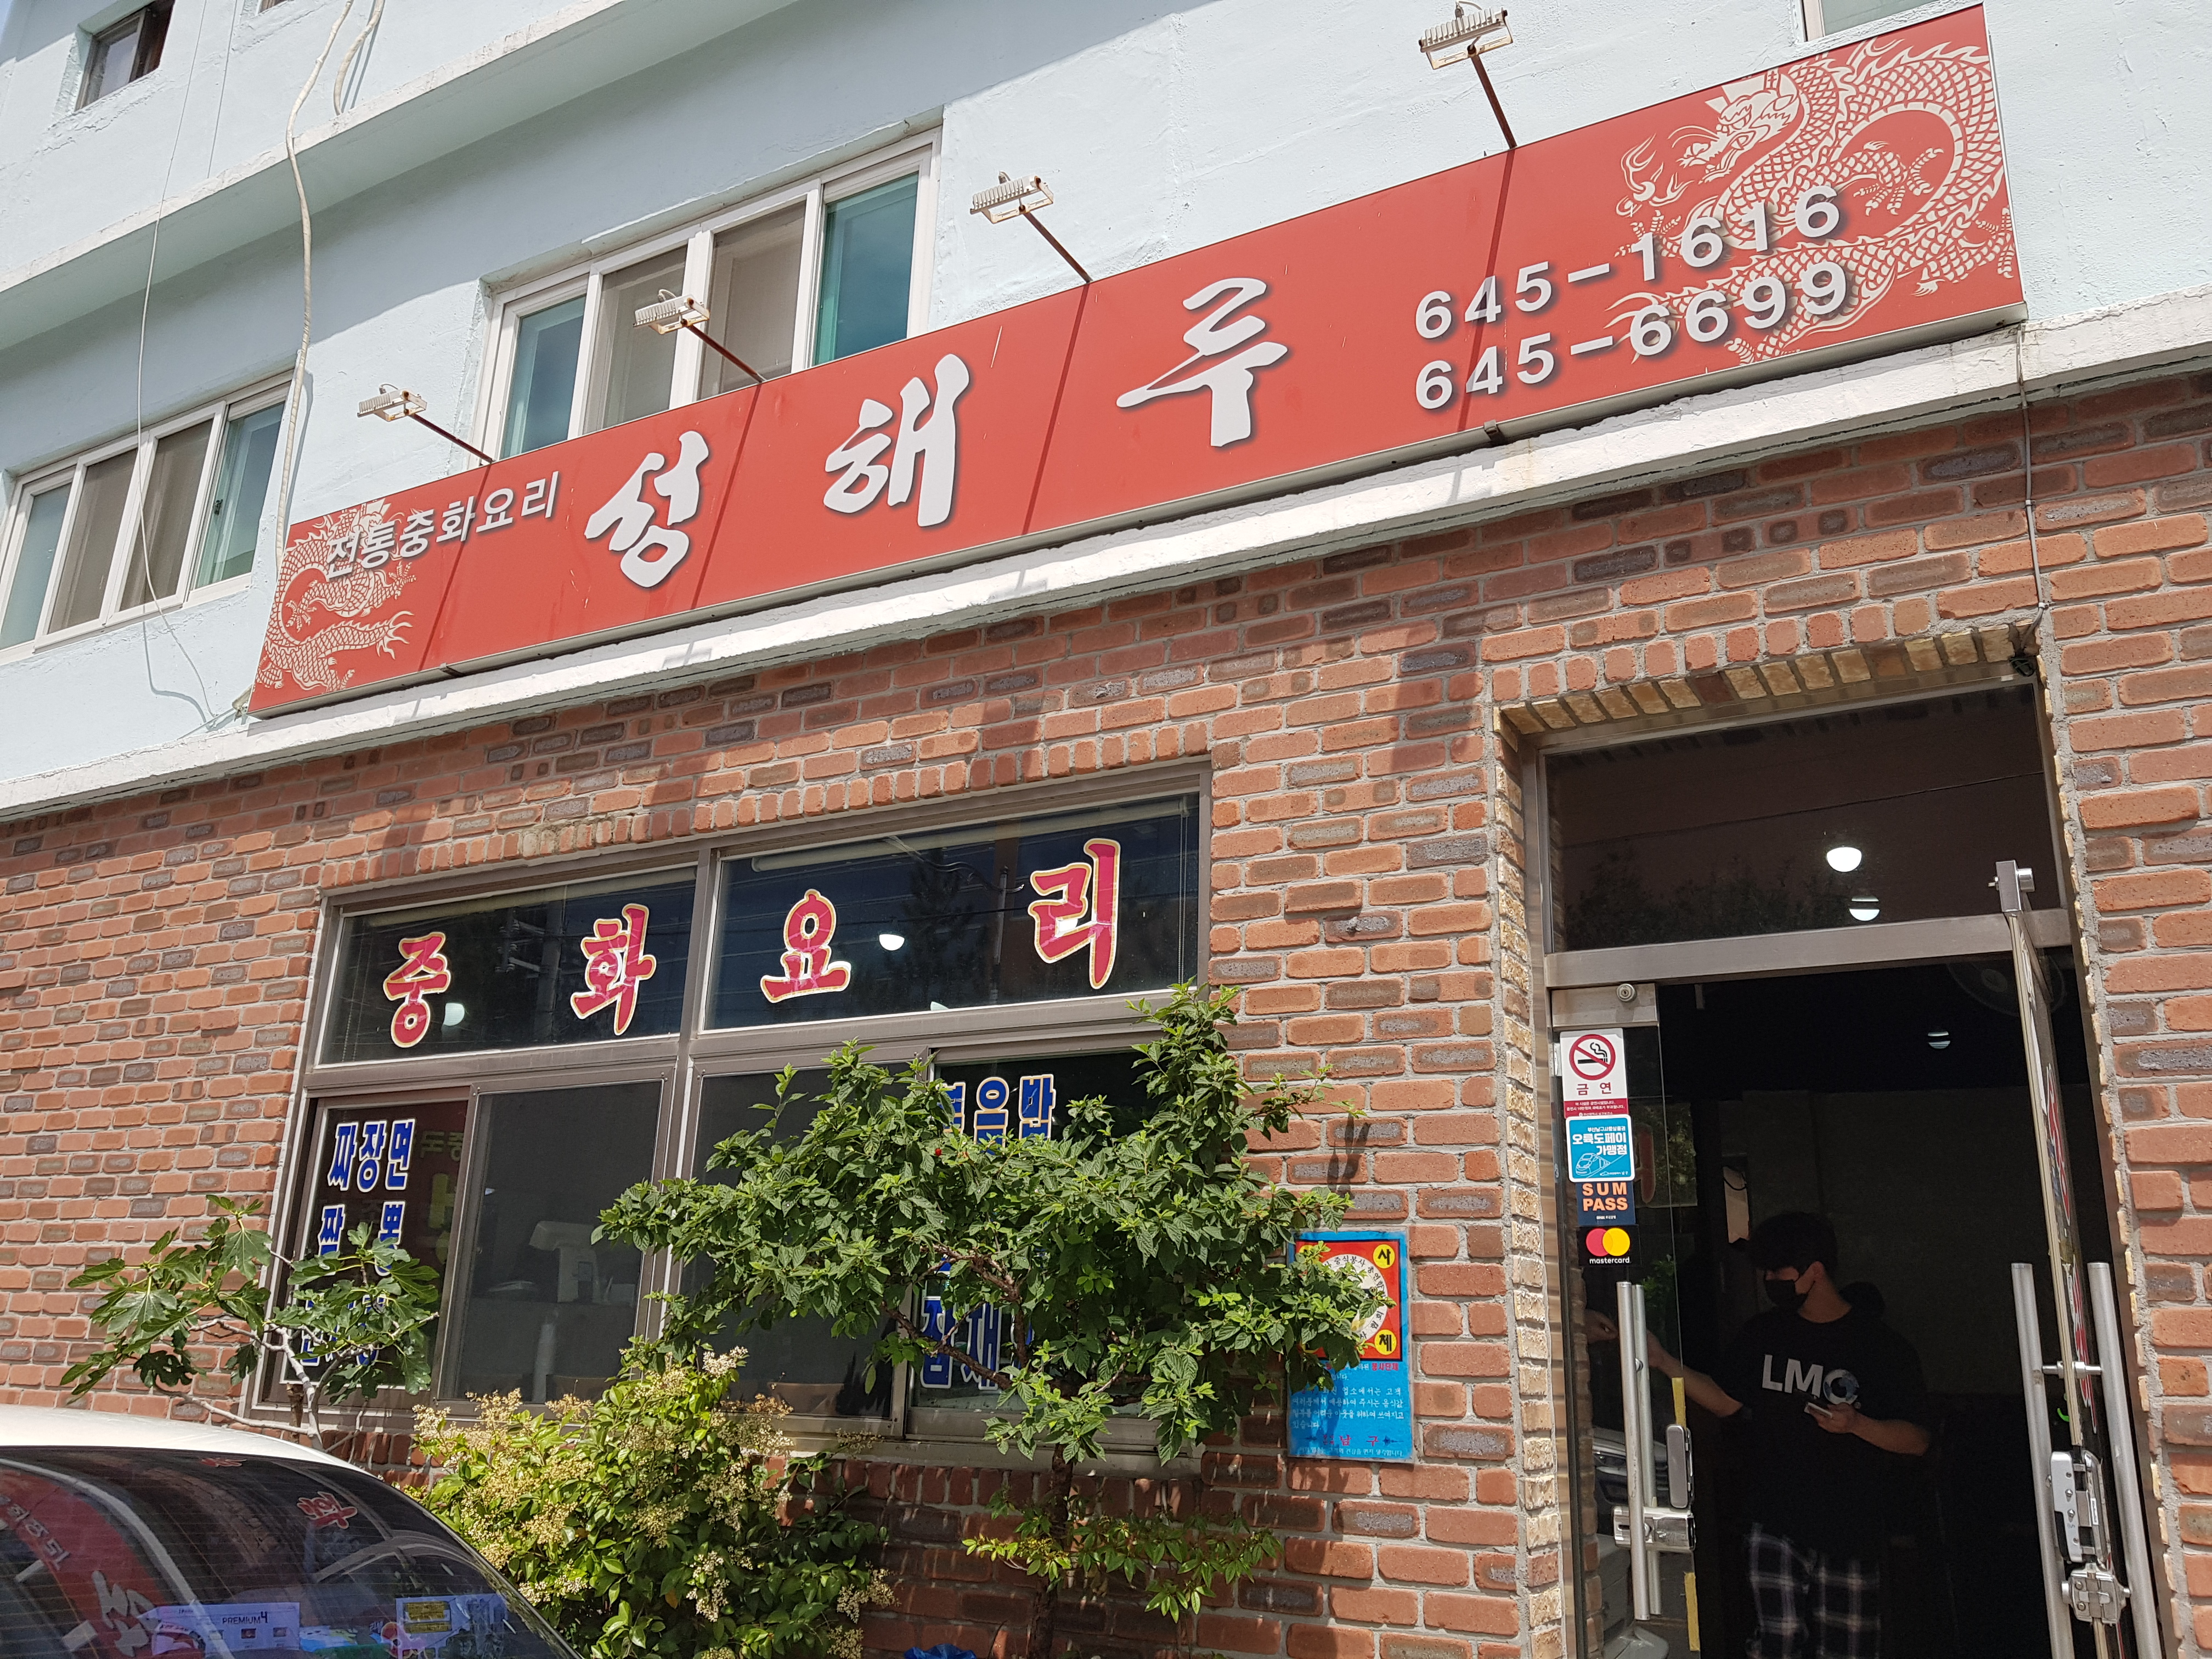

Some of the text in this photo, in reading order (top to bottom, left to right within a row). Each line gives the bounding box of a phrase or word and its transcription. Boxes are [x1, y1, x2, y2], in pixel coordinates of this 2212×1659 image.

[1414, 185, 1841, 339] 645-1616
[1414, 261, 1847, 410] 645-6699
[326, 471, 560, 580] 전통중화요리
[382, 838, 1121, 1048] 중화요리
[1576, 1082, 1611, 1096] 금연
[1572, 1132, 1627, 1144] 오륙도페이
[328, 1118, 416, 1192] 짜장면
[1596, 1144, 1627, 1155] 가맹점
[1582, 1182, 1627, 1197] SUM
[1583, 1197, 1628, 1211] PASS
[1378, 1249, 1391, 1265] 사
[1589, 1256, 1630, 1265] mastercard
[1379, 1334, 1392, 1352] 체
